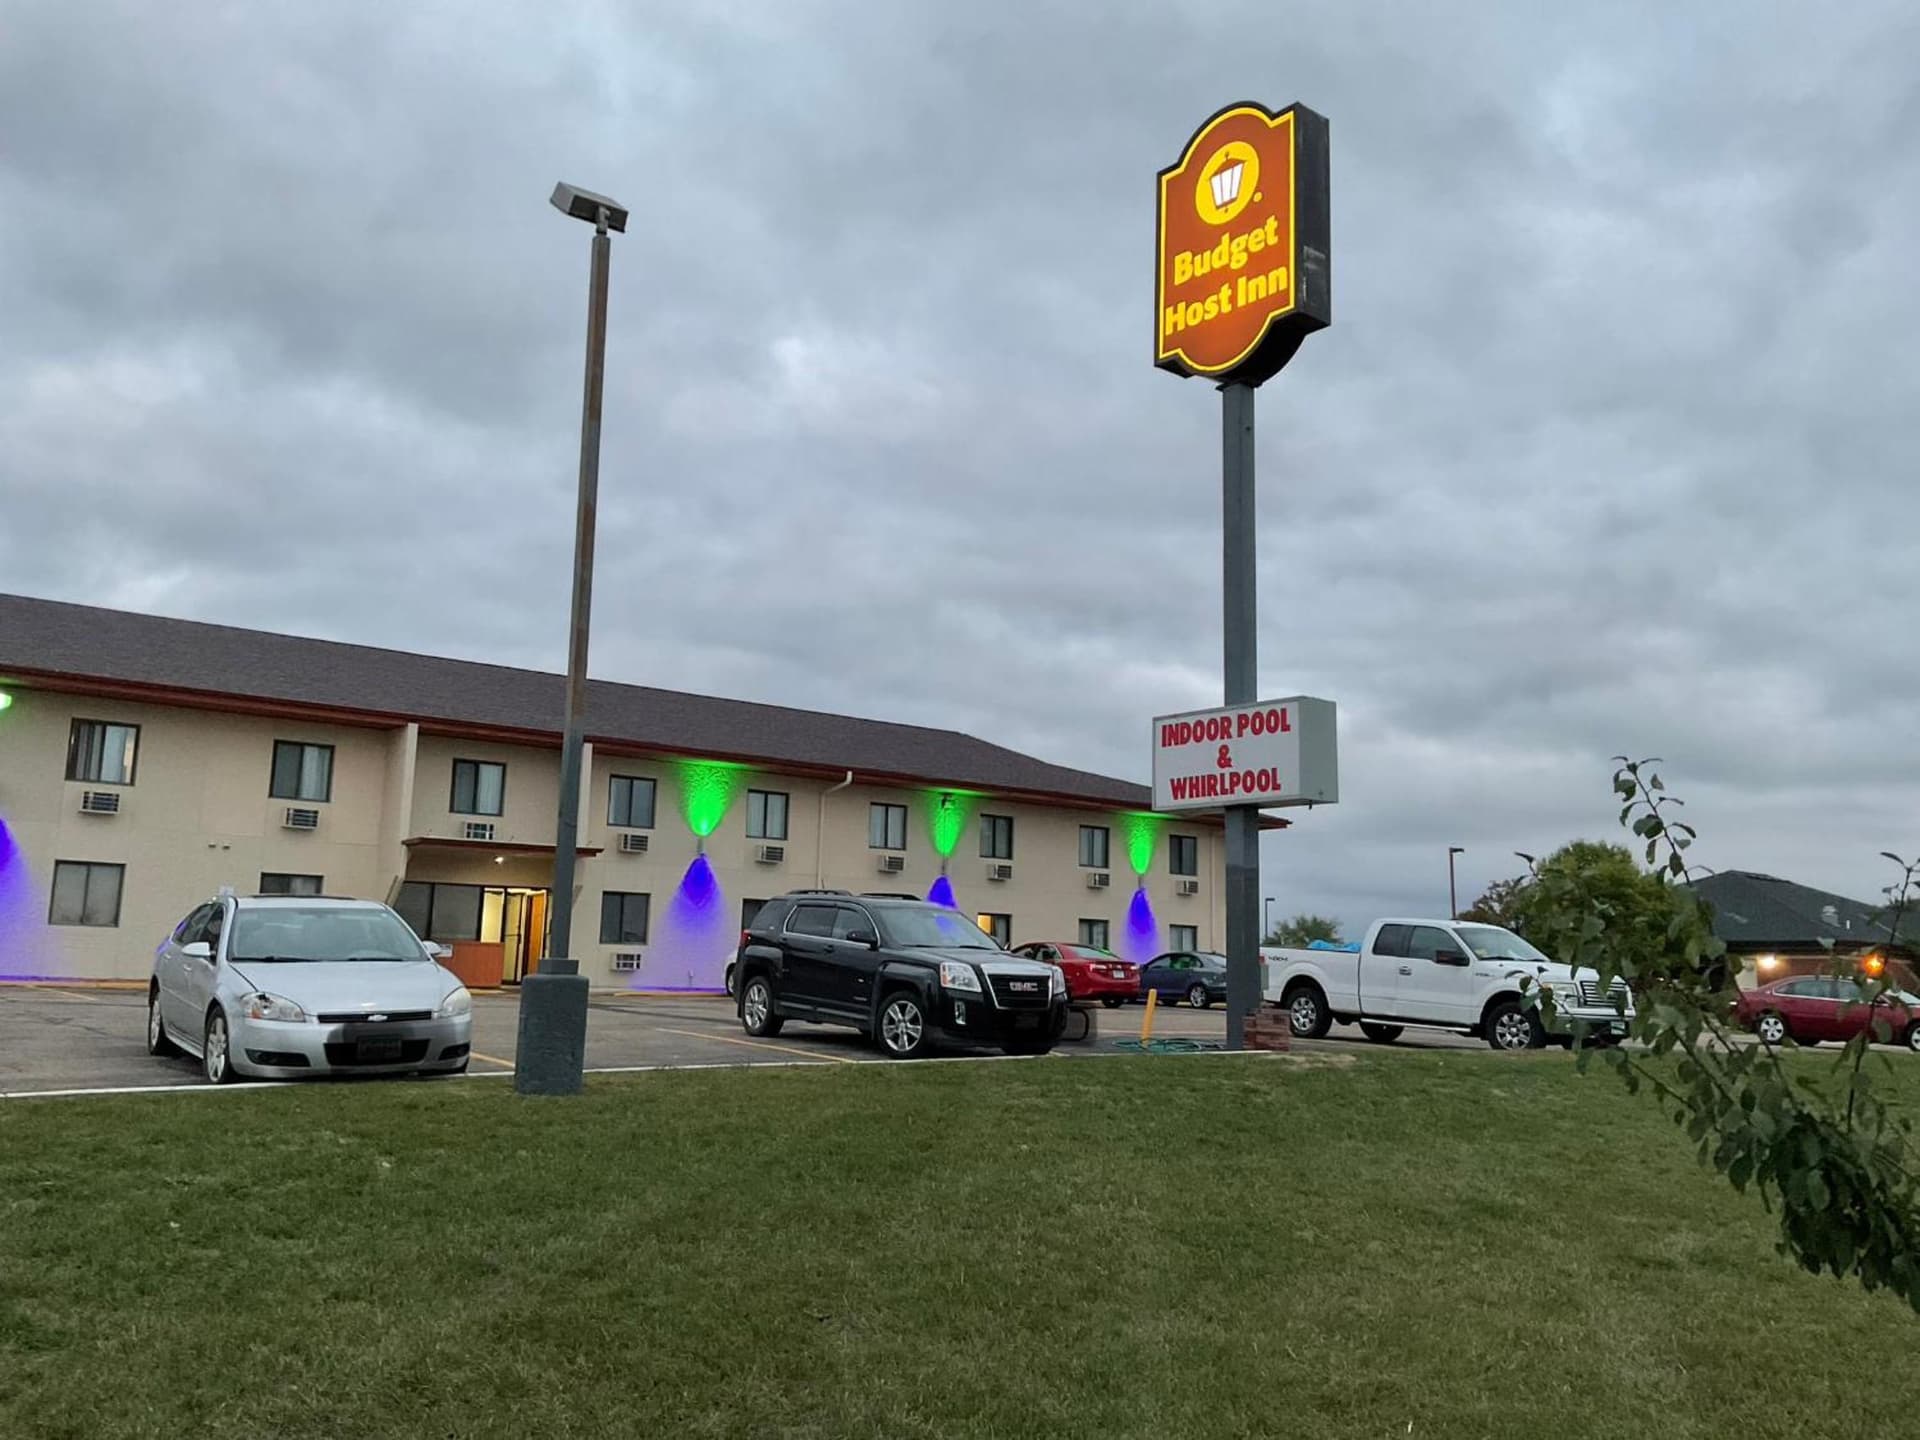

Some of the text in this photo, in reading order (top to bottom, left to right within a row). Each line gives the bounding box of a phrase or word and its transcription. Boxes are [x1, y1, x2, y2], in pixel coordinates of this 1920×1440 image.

[1173, 215, 1279, 286] Budget
[1165, 266, 1288, 336] Host Inn
[1161, 708, 1291, 748] INDOOR POOL
[1217, 744, 1232, 769] &
[1170, 767, 1281, 800] WHIRLPOOL
